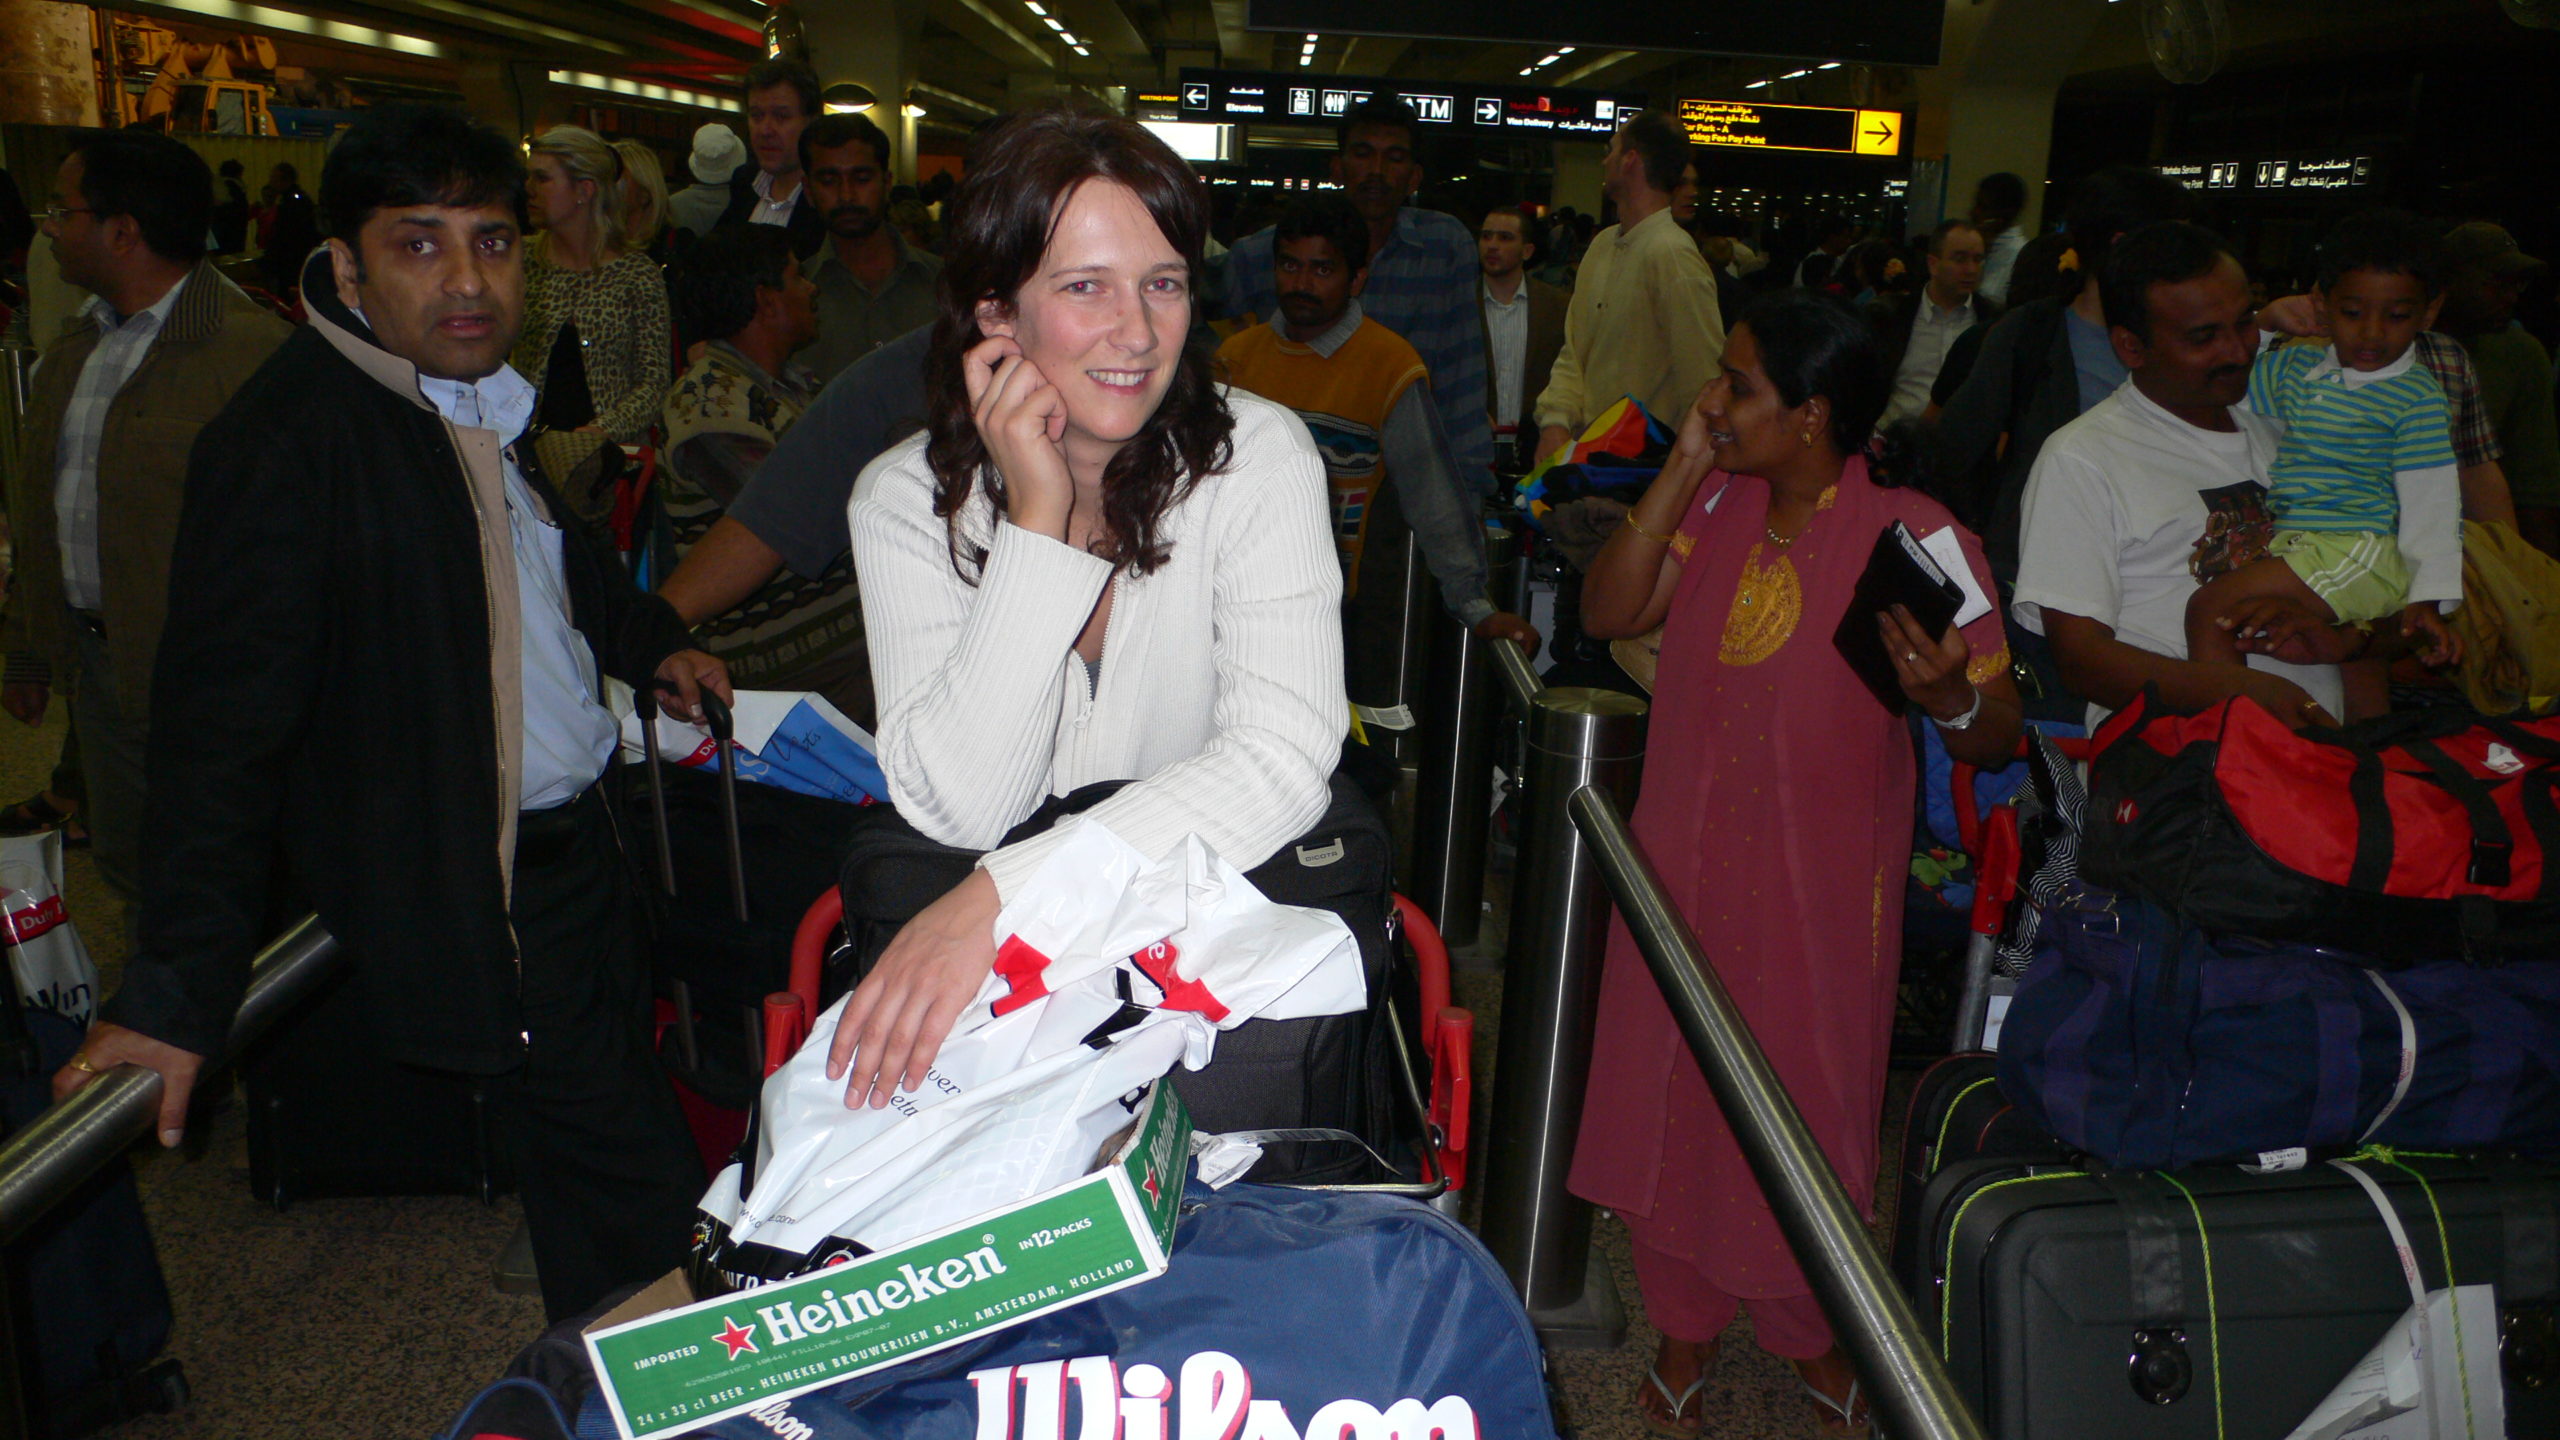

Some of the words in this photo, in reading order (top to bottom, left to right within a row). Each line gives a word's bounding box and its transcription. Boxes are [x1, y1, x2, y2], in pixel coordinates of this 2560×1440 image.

[1139, 94, 1162, 102] MEETING
[1226, 102, 1265, 113] Elevators
[1506, 117, 1523, 126] Visa
[1523, 118, 1554, 129] Delivery
[1697, 123, 1715, 132] Park
[1721, 125, 1729, 133] A
[1711, 134, 1727, 143] Fee
[1727, 134, 1743, 145] Pay
[1744, 135, 1766, 144] Point
[1018, 1238, 1034, 1251] IN
[1031, 1229, 1055, 1249] 12
[1053, 1217, 1093, 1240] PACKS
[637, 1413, 654, 1427] 24
[660, 1411, 668, 1421] x
[671, 1403, 688, 1417] 33
[693, 1396, 706, 1410] cl
[710, 1386, 745, 1405] BEER
[760, 1362, 827, 1389] HEINEKEN
[831, 1328, 929, 1369] BROUWERIJEN
[974, 1284, 1065, 1322] AMSTERDAM,
[1068, 1257, 1135, 1289] HOLLAND
[633, 1344, 700, 1371] IMPORTED
